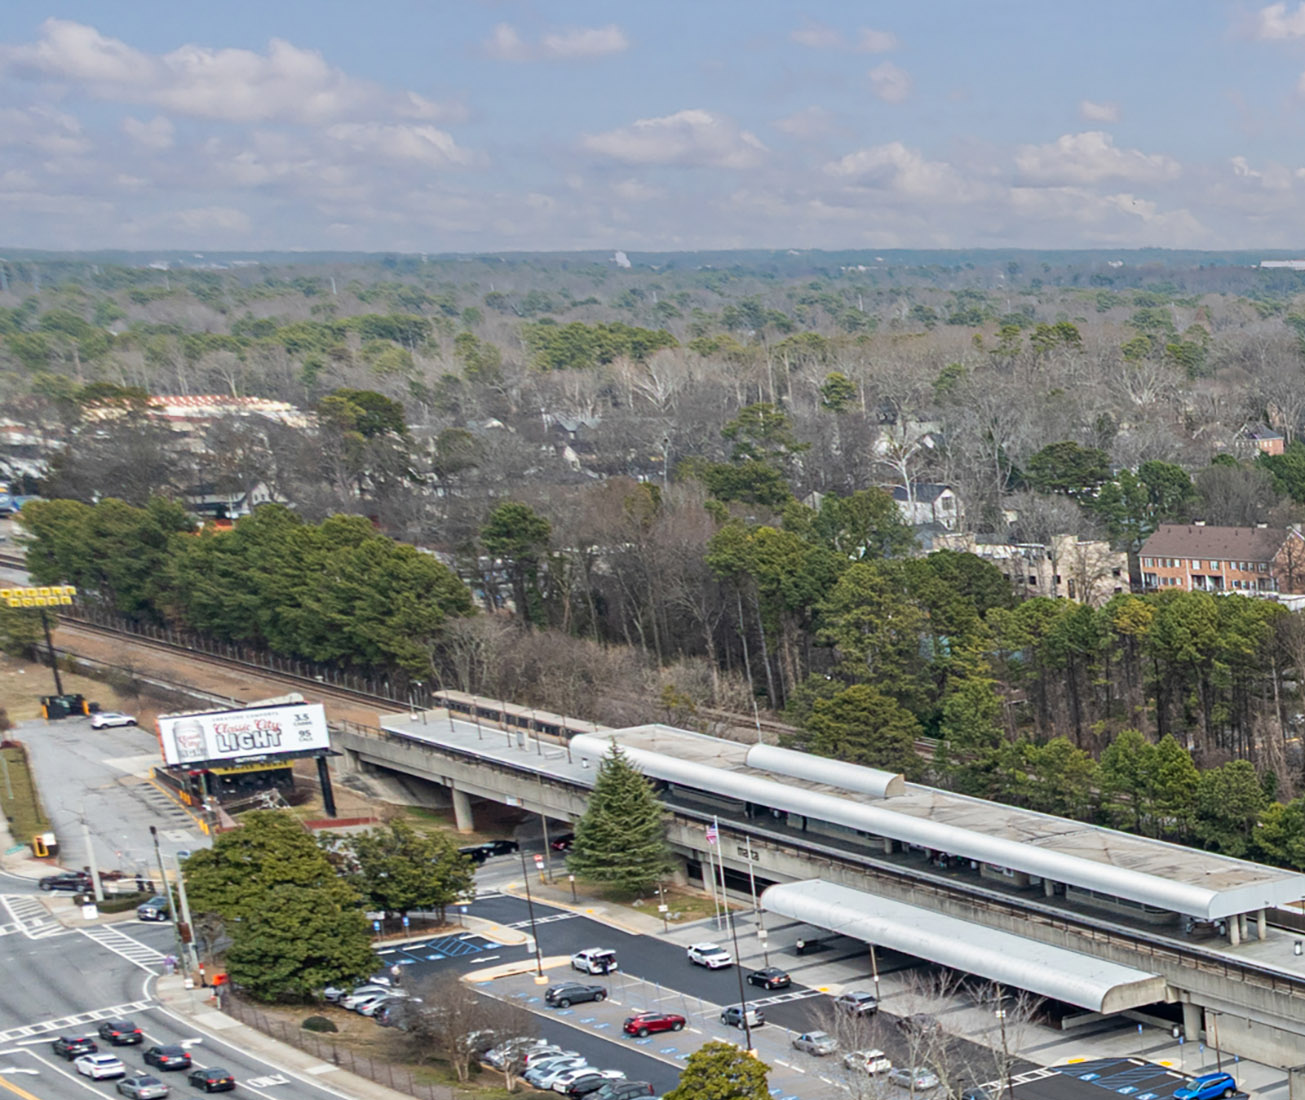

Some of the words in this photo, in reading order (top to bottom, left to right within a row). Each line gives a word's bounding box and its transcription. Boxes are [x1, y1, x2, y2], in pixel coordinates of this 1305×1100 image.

[213, 721, 250, 736] Classic
[254, 719, 283, 732] City
[216, 729, 282, 753] LIGHT
